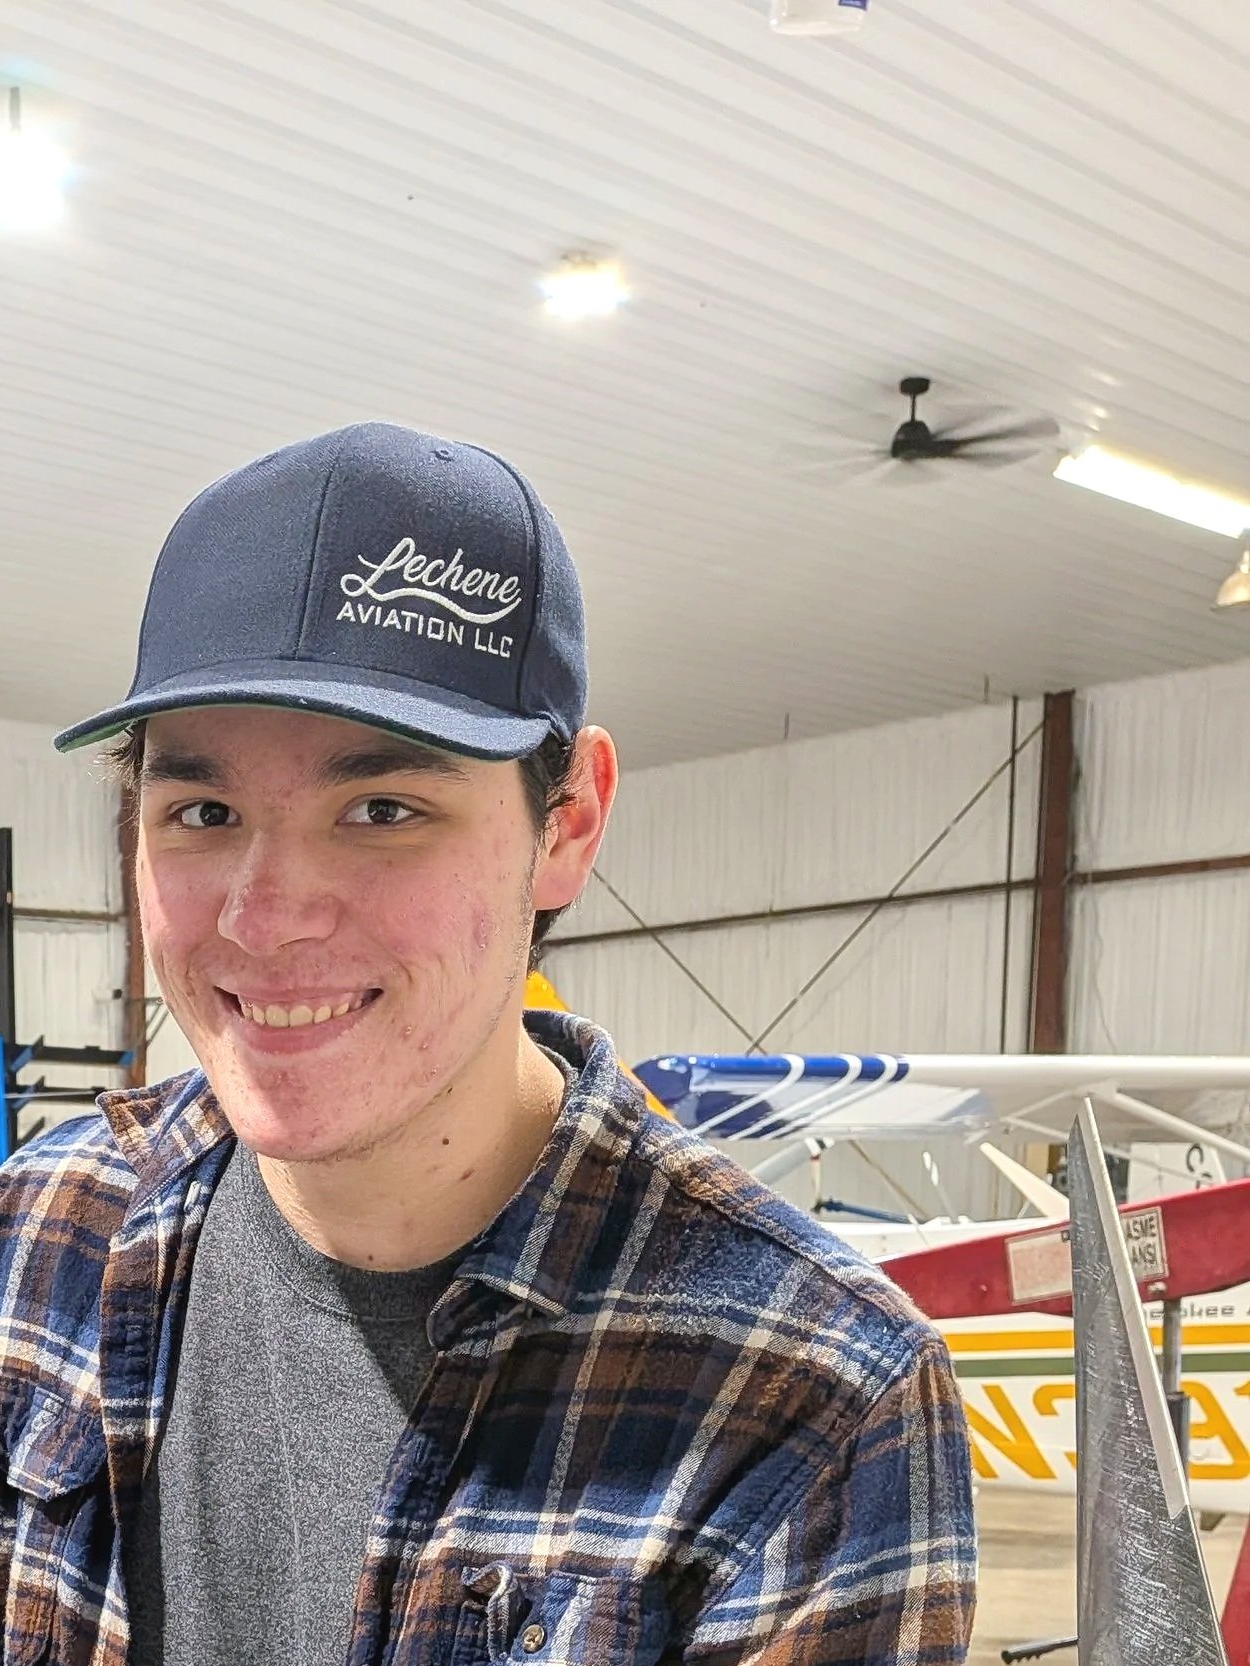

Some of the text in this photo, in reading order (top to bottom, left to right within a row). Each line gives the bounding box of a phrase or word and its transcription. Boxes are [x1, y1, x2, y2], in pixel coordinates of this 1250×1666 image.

[339, 536, 522, 625] Lechene
[335, 600, 514, 659] AVIATION LLC
